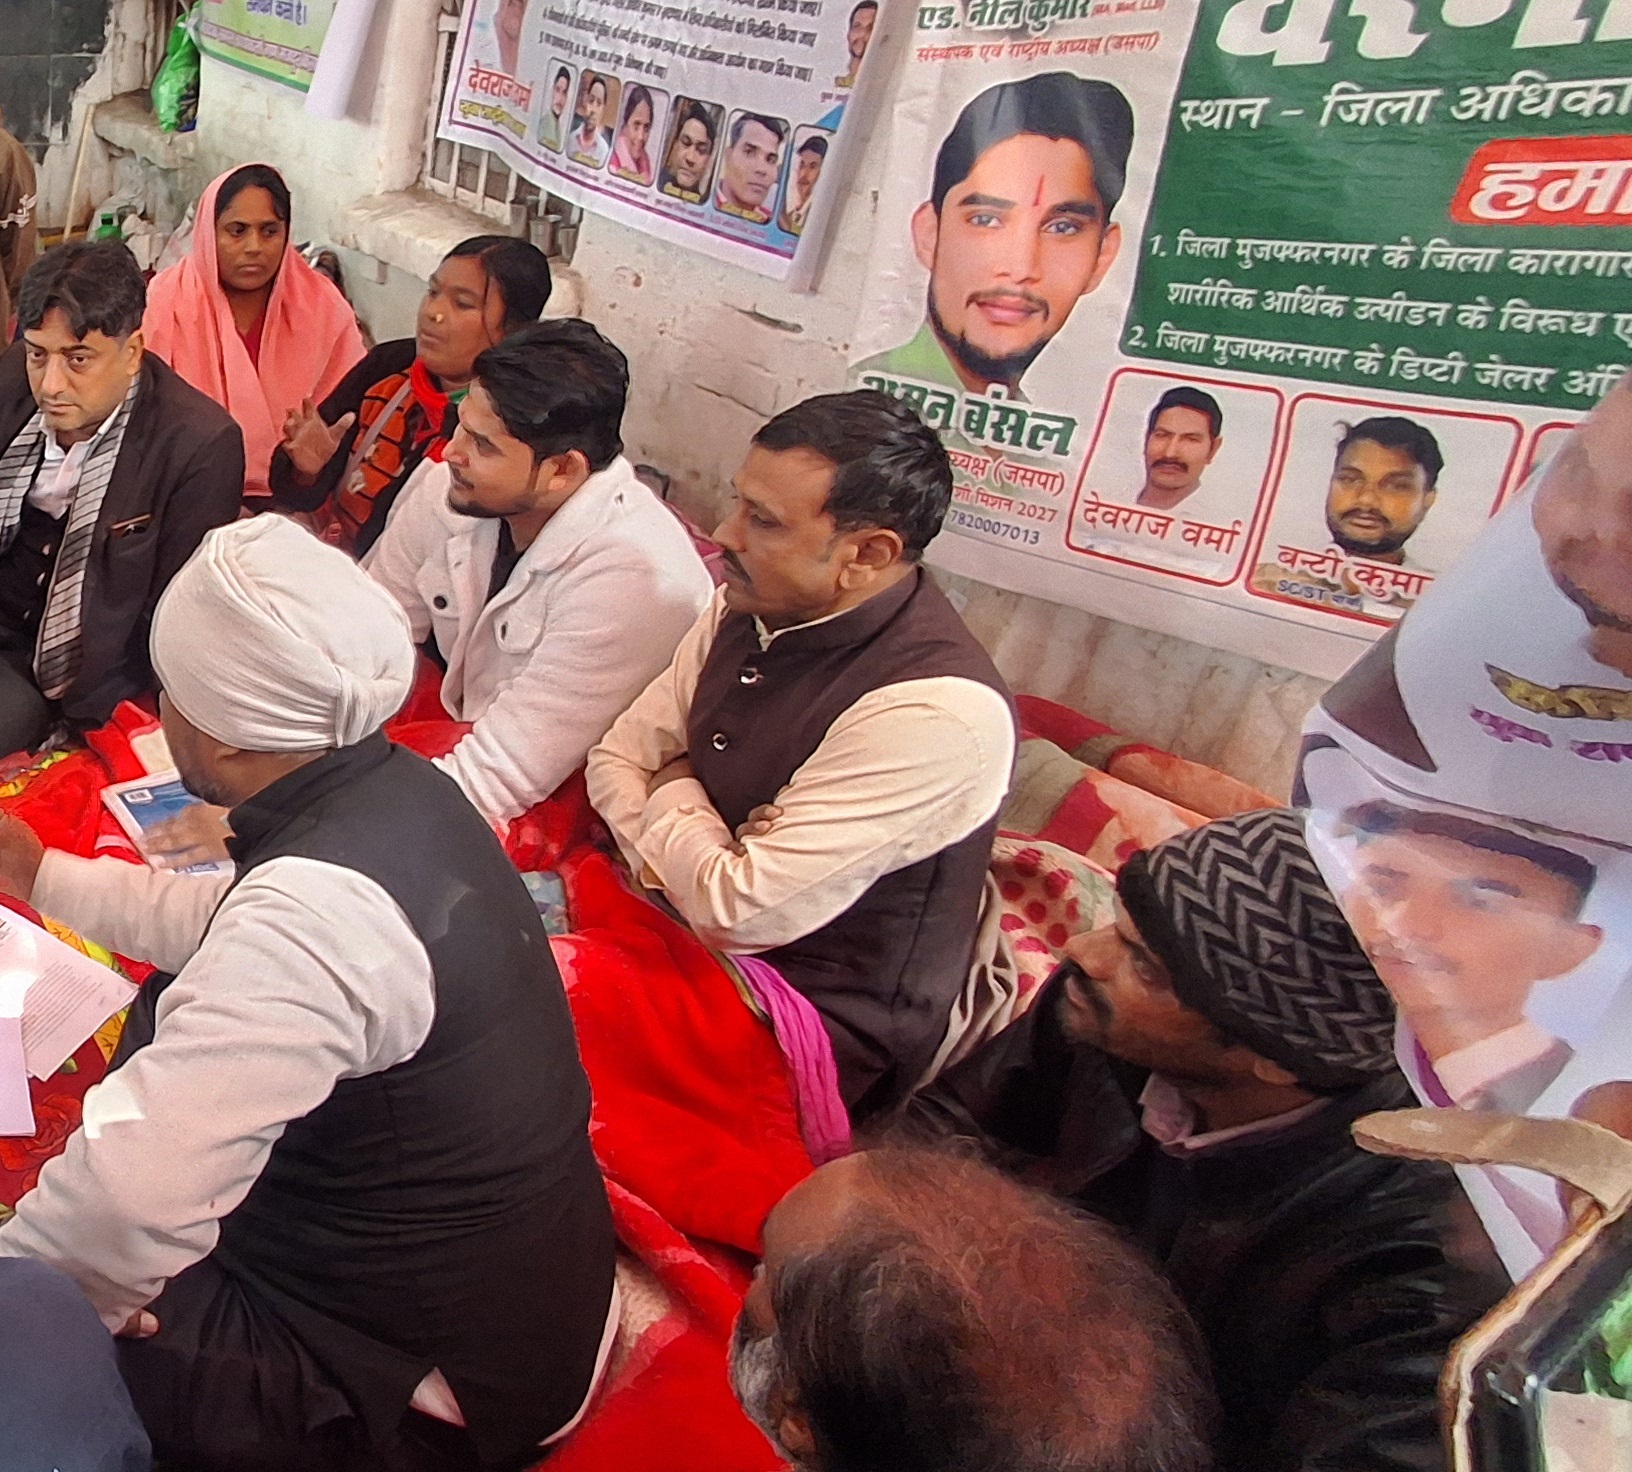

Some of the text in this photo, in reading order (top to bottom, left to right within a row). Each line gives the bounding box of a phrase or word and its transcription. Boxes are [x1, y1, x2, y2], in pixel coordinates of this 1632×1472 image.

[919, 6, 960, 29] एड.
[1027, 0, 1090, 32] कुमार
[979, 41, 1003, 63] एवं
[1008, 36, 1054, 63] राष्ट्रीय
[1054, 36, 1104, 57] अध्यक्ष
[1180, 97, 1270, 132] स्थान
[1319, 81, 1444, 128] जिला
[1149, 234, 1167, 257] 1.
[1176, 228, 1232, 259] जिला
[1381, 235, 1418, 269] के
[1419, 237, 1504, 273] जिला
[1167, 276, 1259, 311] शारीरिक
[1261, 284, 1351, 319] आर्थिक
[1456, 294, 1495, 330] के
[1128, 325, 1148, 349] 2.
[1156, 320, 1210, 353] जिला
[1353, 342, 1385, 375] के
[1389, 345, 1467, 385] डिप्टी
[1473, 353, 1558, 393] जेलर
[964, 390, 1079, 456] बंसल
[947, 450, 1065, 497] ध्यक्ष (जसपा)
[950, 509, 1040, 546] 7820007013
[975, 487, 1015, 512] मिशन
[1017, 501, 1059, 523] 2027
[1082, 491, 1242, 555] देवराज वर्मा
[1277, 543, 1434, 600] बन्टी कुमा
